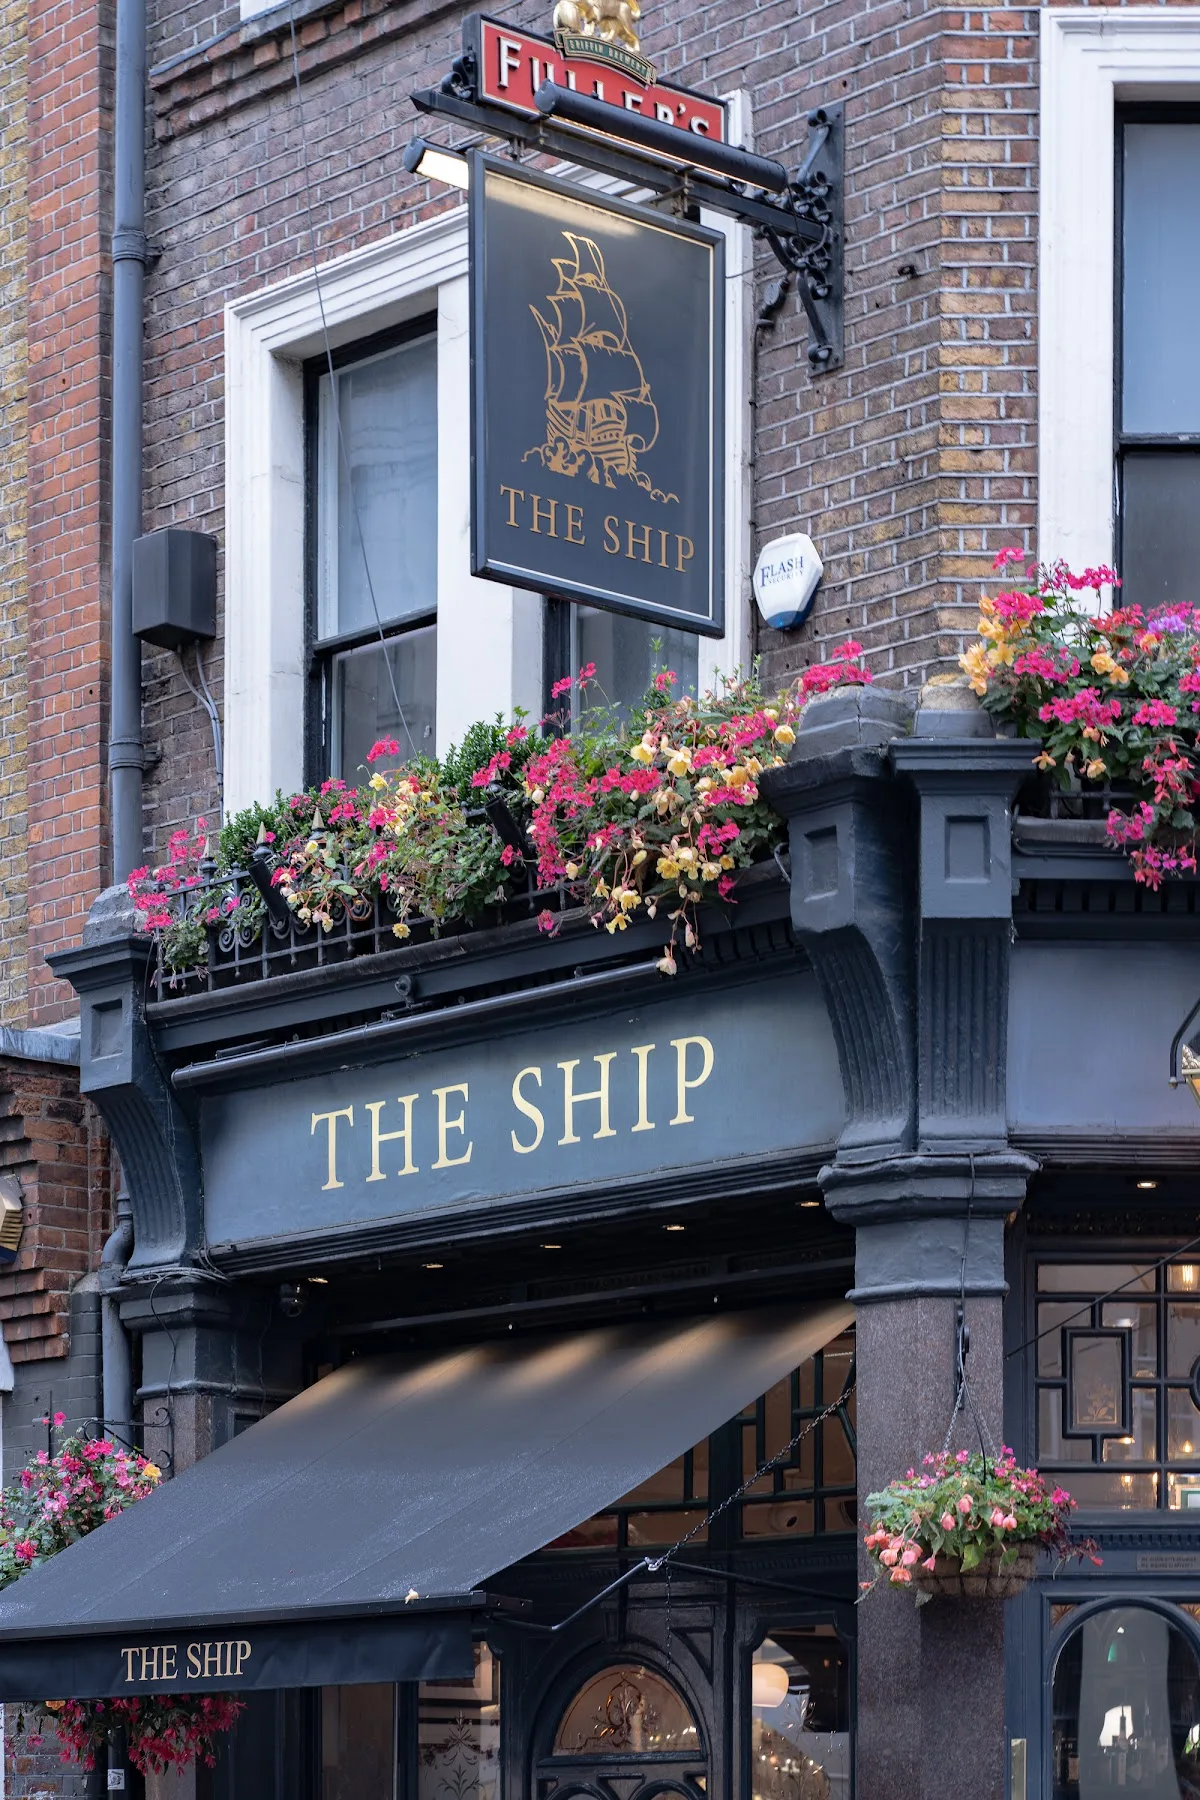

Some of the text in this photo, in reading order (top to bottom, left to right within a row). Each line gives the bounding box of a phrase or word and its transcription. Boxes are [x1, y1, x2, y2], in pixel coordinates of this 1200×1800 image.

[500, 484, 695, 573] THE SHIP
[760, 556, 804, 588] FLASH
[768, 570, 803, 584] SECURITY
[310, 1035, 715, 1191] THE SHIP
[120, 1640, 252, 1682] THE SHIP
